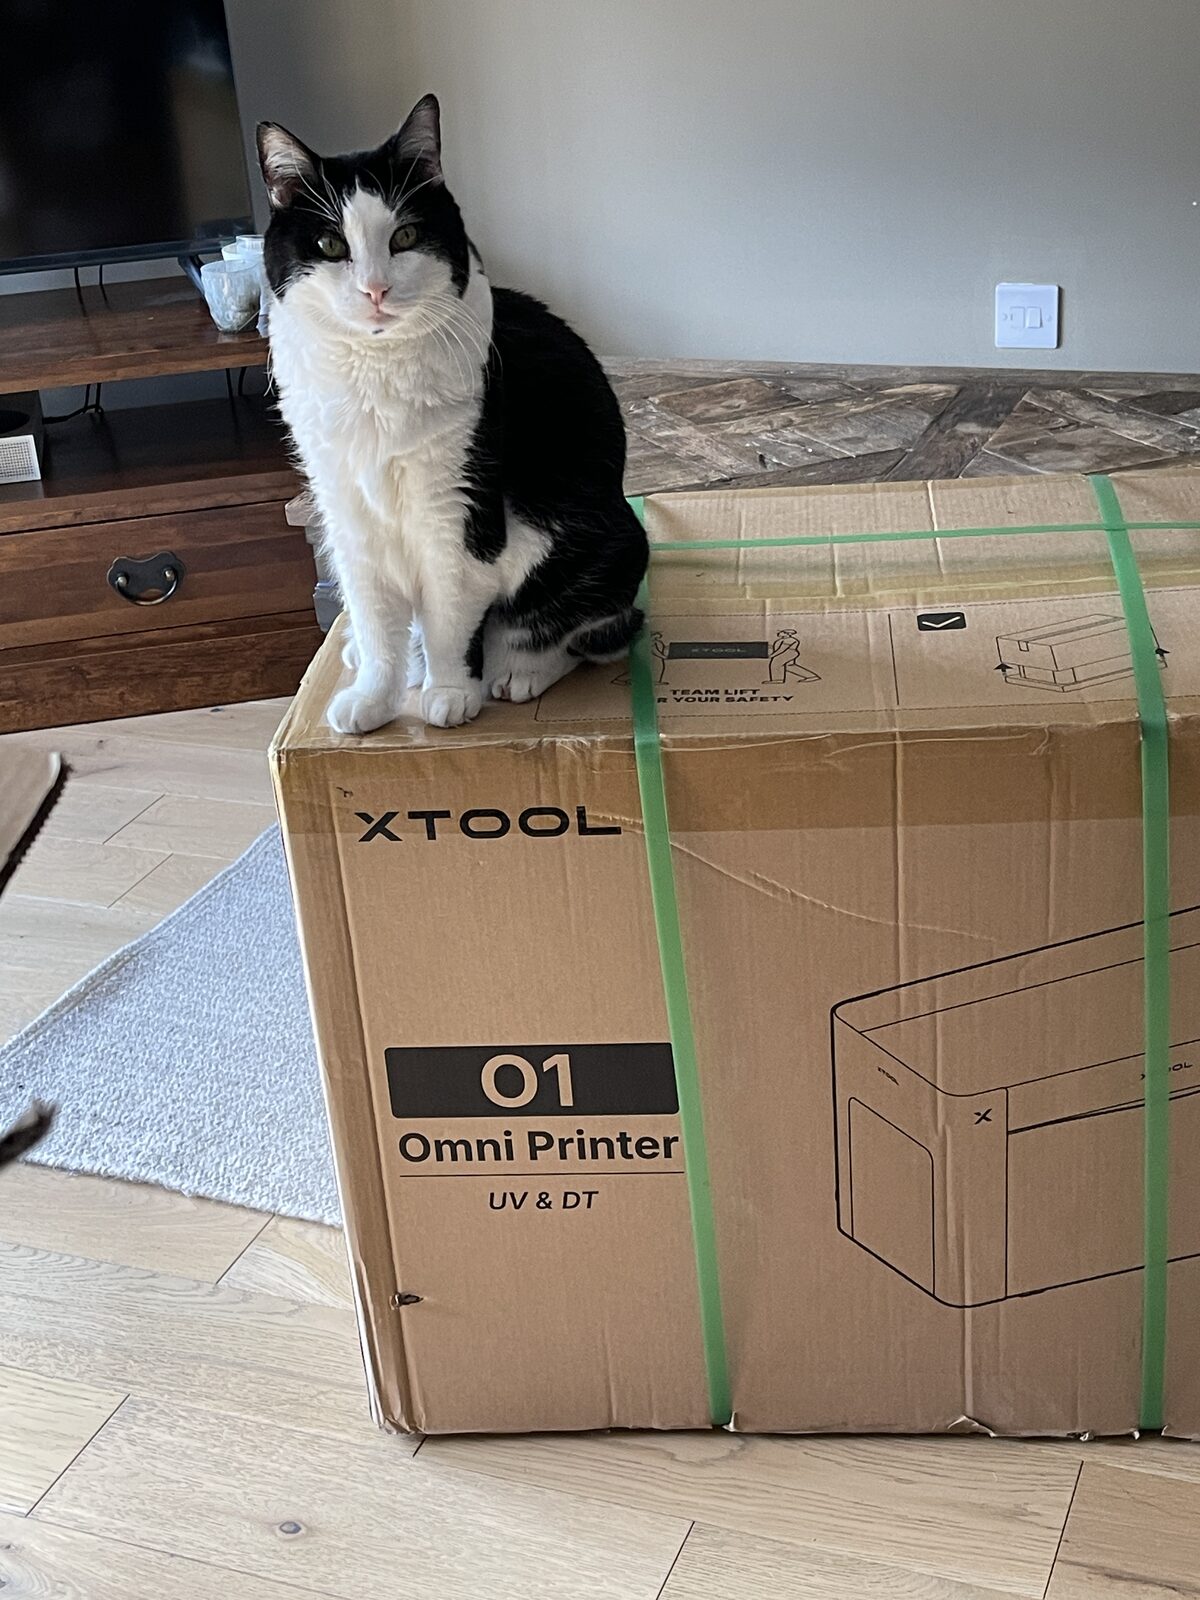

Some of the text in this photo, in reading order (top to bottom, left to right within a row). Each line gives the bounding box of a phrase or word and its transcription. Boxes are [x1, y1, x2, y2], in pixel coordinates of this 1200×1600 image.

[725, 695, 794, 703] SAFETY
[354, 805, 622, 842] XTOOL
[399, 1129, 679, 1162] Omni Printer
[489, 1190, 599, 1210] UV & DT
